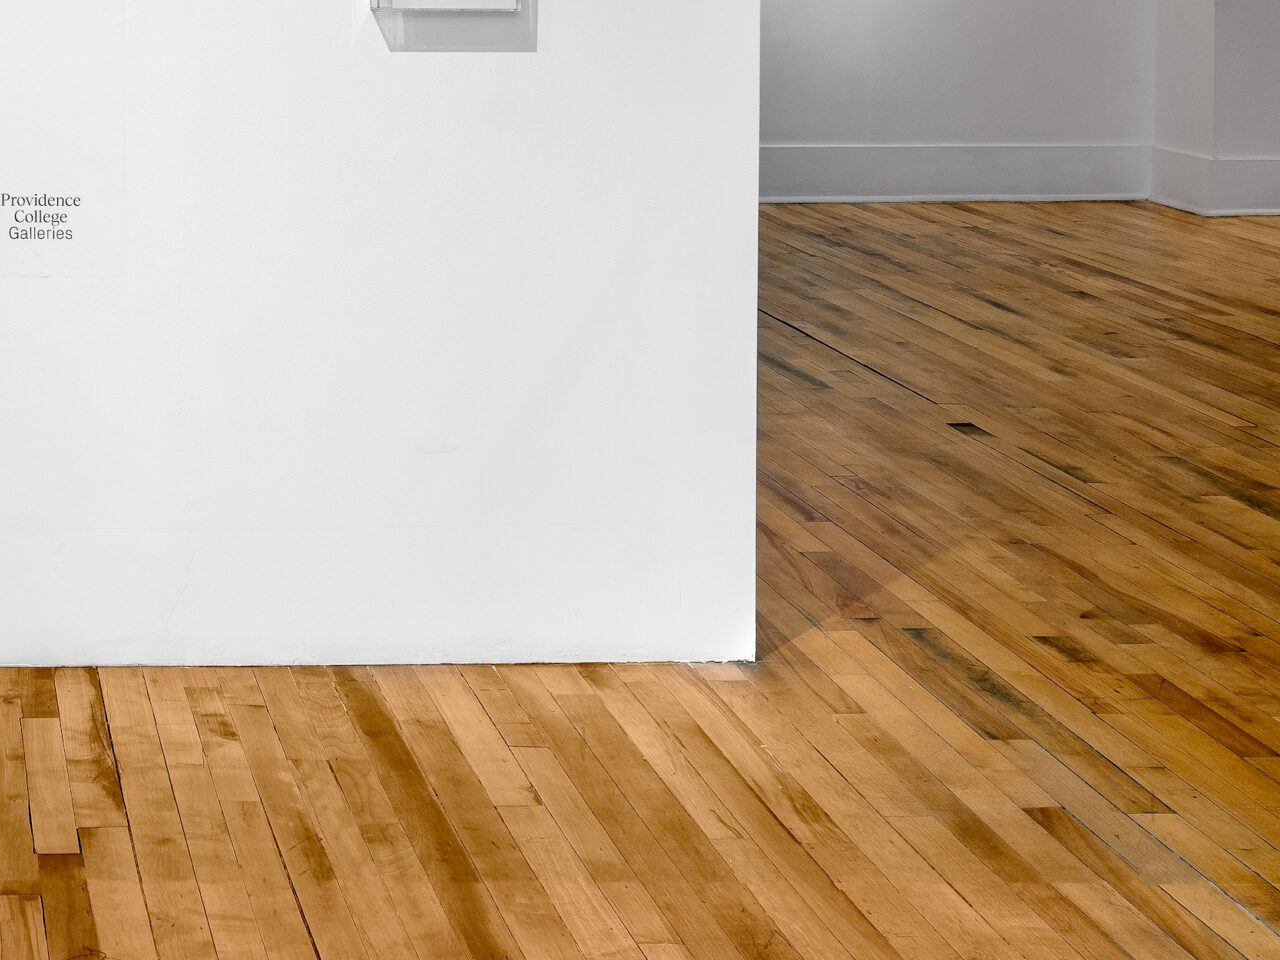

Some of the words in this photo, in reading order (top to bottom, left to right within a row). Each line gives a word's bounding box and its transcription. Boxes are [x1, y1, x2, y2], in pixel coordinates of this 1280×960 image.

[0, 192, 81, 207] Providence
[13, 209, 68, 227] College
[8, 226, 74, 240] Galleries
